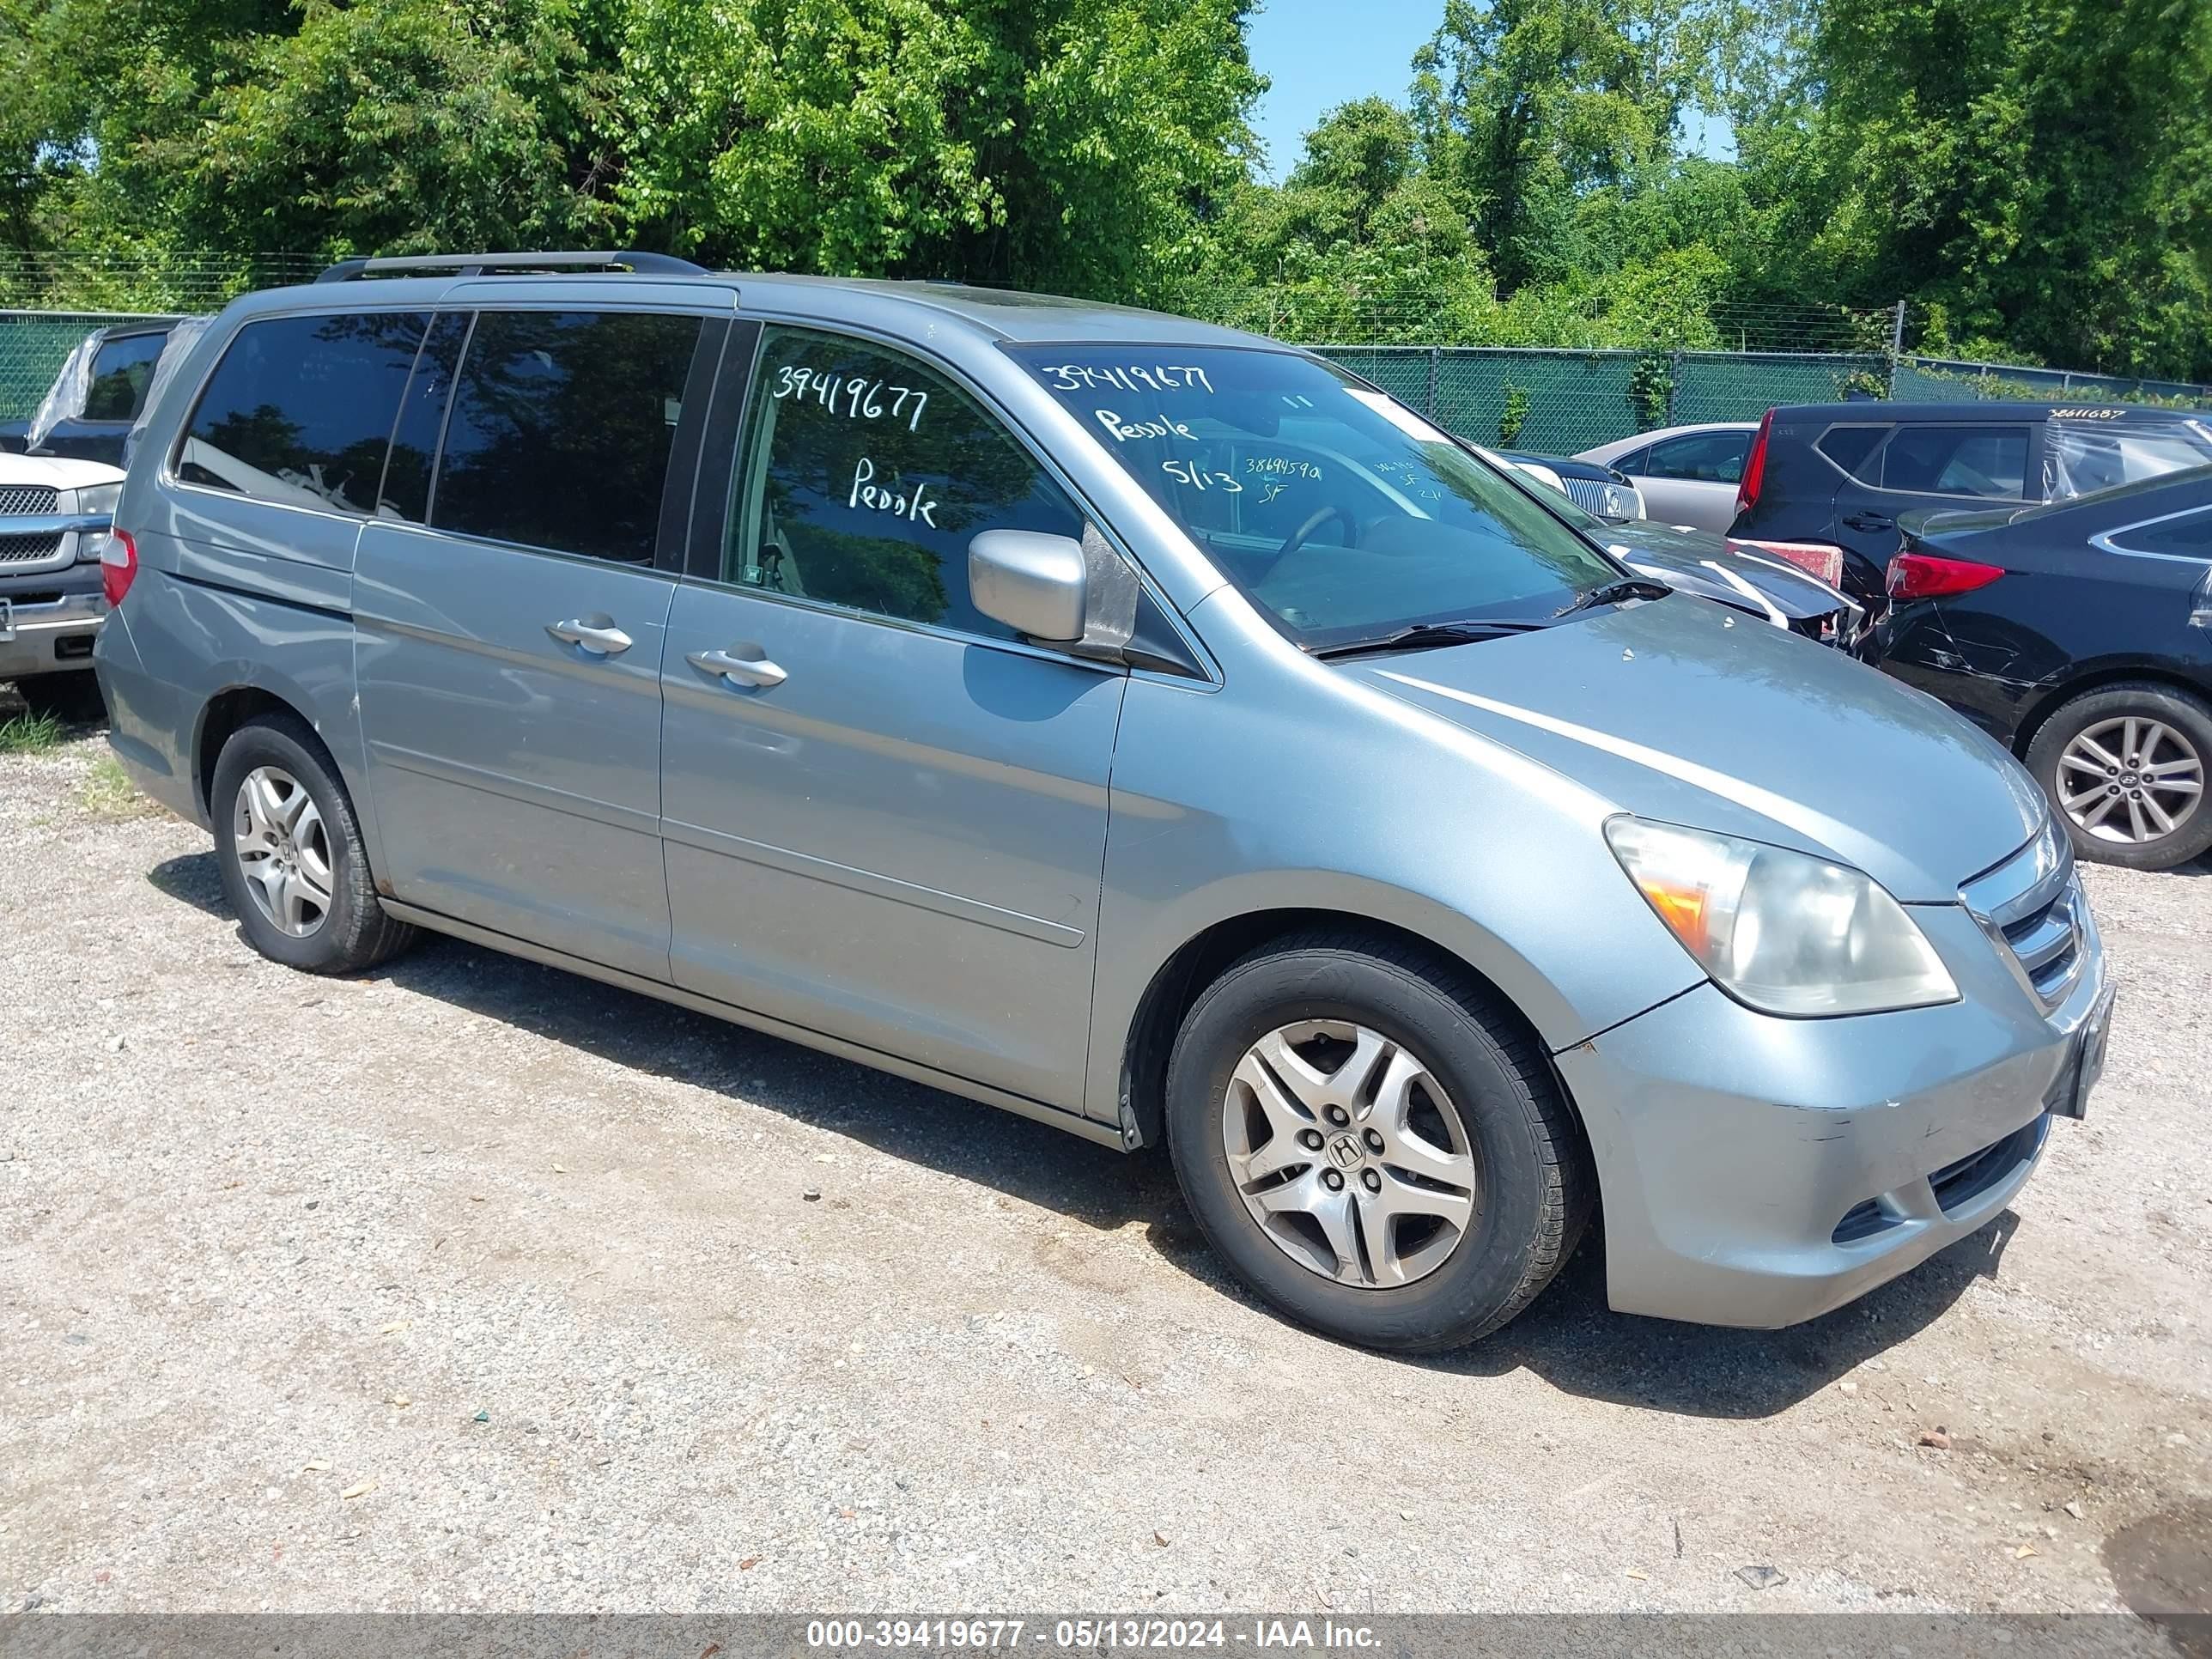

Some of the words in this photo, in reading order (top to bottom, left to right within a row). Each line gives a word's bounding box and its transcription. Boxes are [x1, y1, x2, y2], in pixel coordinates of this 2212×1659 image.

[1042, 365, 1214, 394] 39419677
[774, 366, 927, 432] 39419677
[2048, 409, 2127, 420] 38611687
[1161, 460, 1243, 491] 5/13
